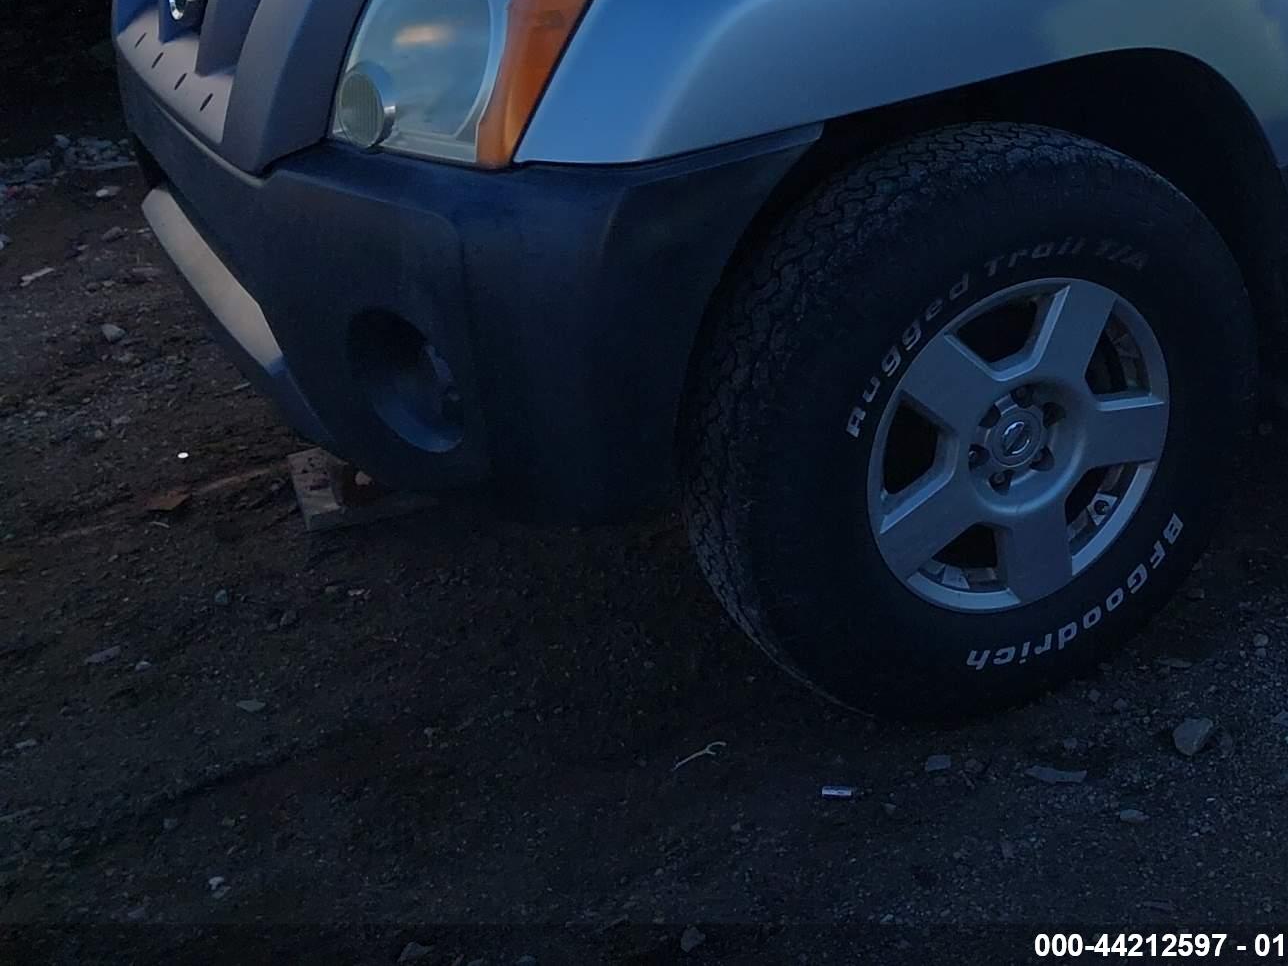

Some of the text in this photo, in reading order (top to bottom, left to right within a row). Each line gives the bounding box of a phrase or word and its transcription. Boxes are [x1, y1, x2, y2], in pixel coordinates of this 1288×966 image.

[845, 272, 971, 439] Rugged
[983, 237, 1086, 277] Trail
[965, 512, 1185, 671] BFGoodrich
